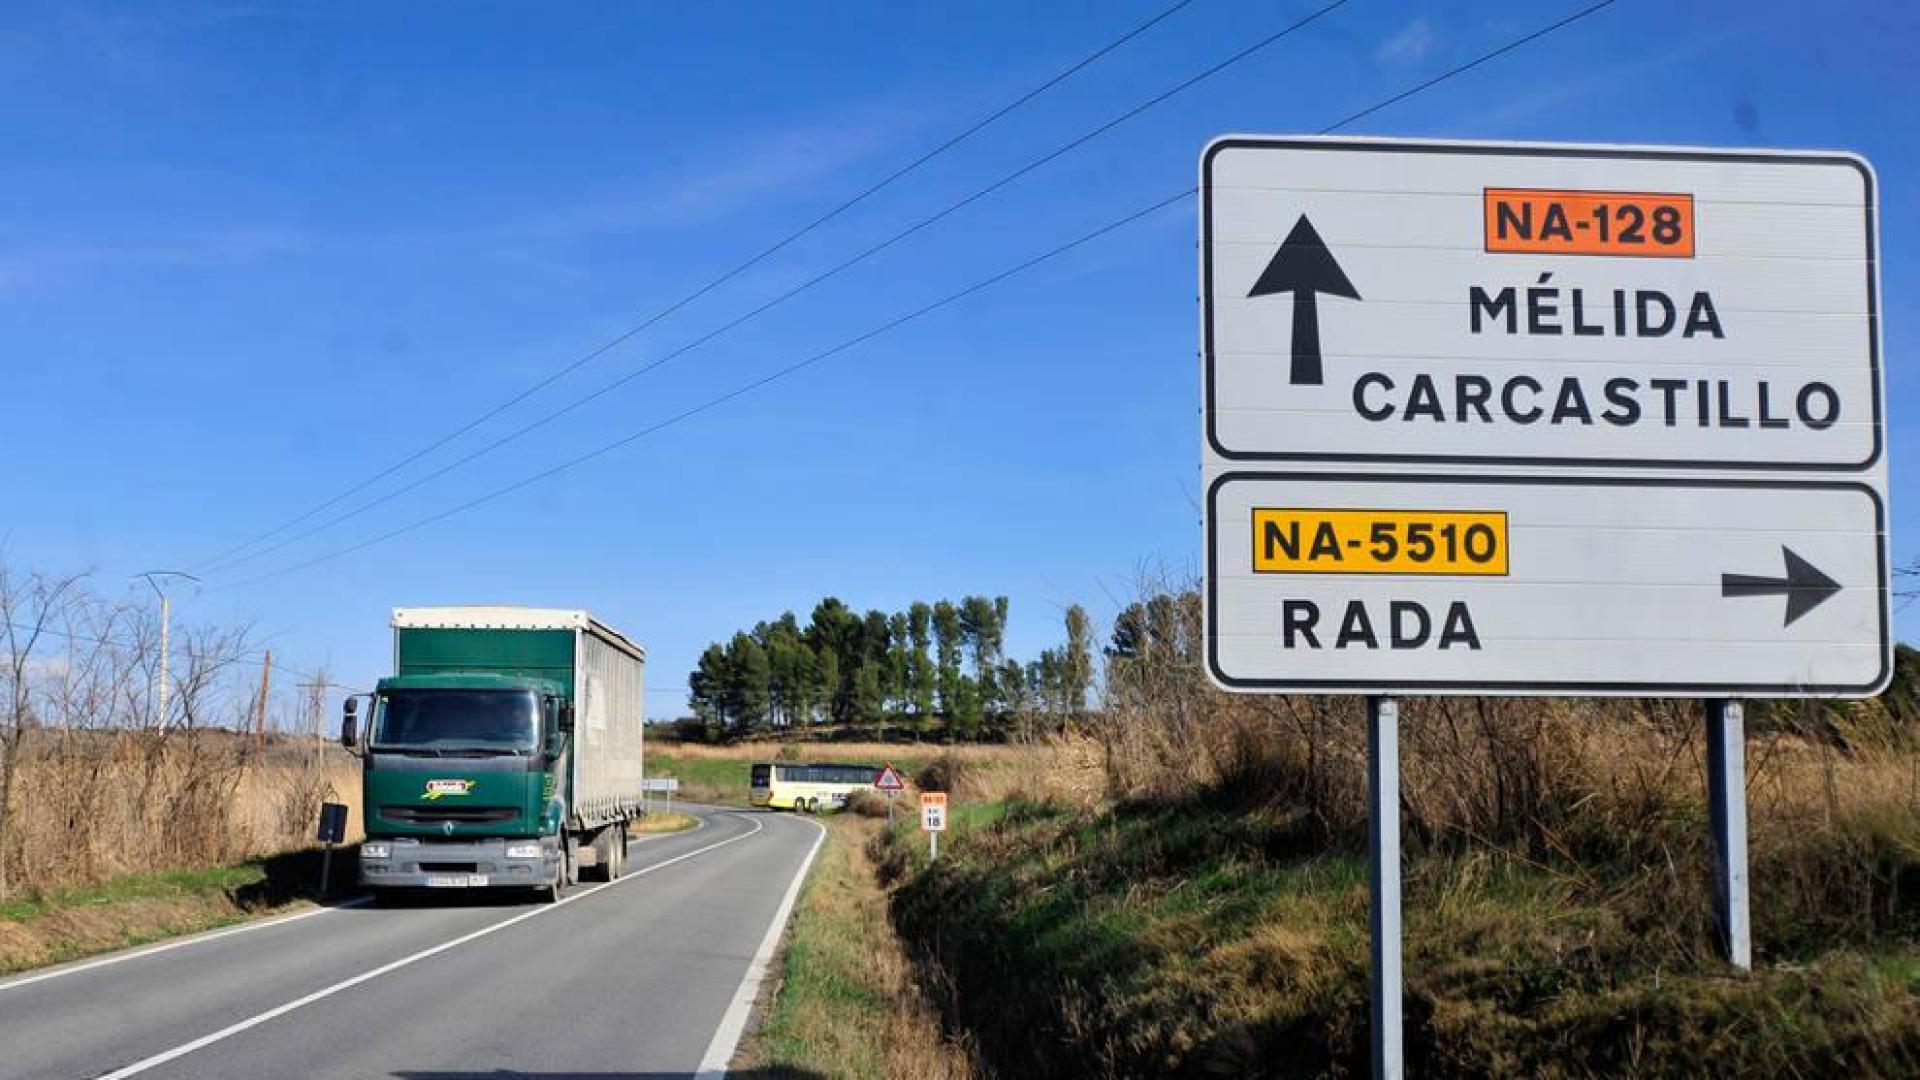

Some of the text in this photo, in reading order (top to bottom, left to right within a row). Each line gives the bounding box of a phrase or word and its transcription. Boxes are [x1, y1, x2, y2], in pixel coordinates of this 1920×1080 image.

[1496, 200, 1682, 246] NA-128
[1470, 272, 1723, 339] MÉLIDA
[1353, 372, 1840, 430] CARCASTILLO
[1264, 520, 1496, 563] NA-5510
[1283, 600, 1481, 650] RADA
